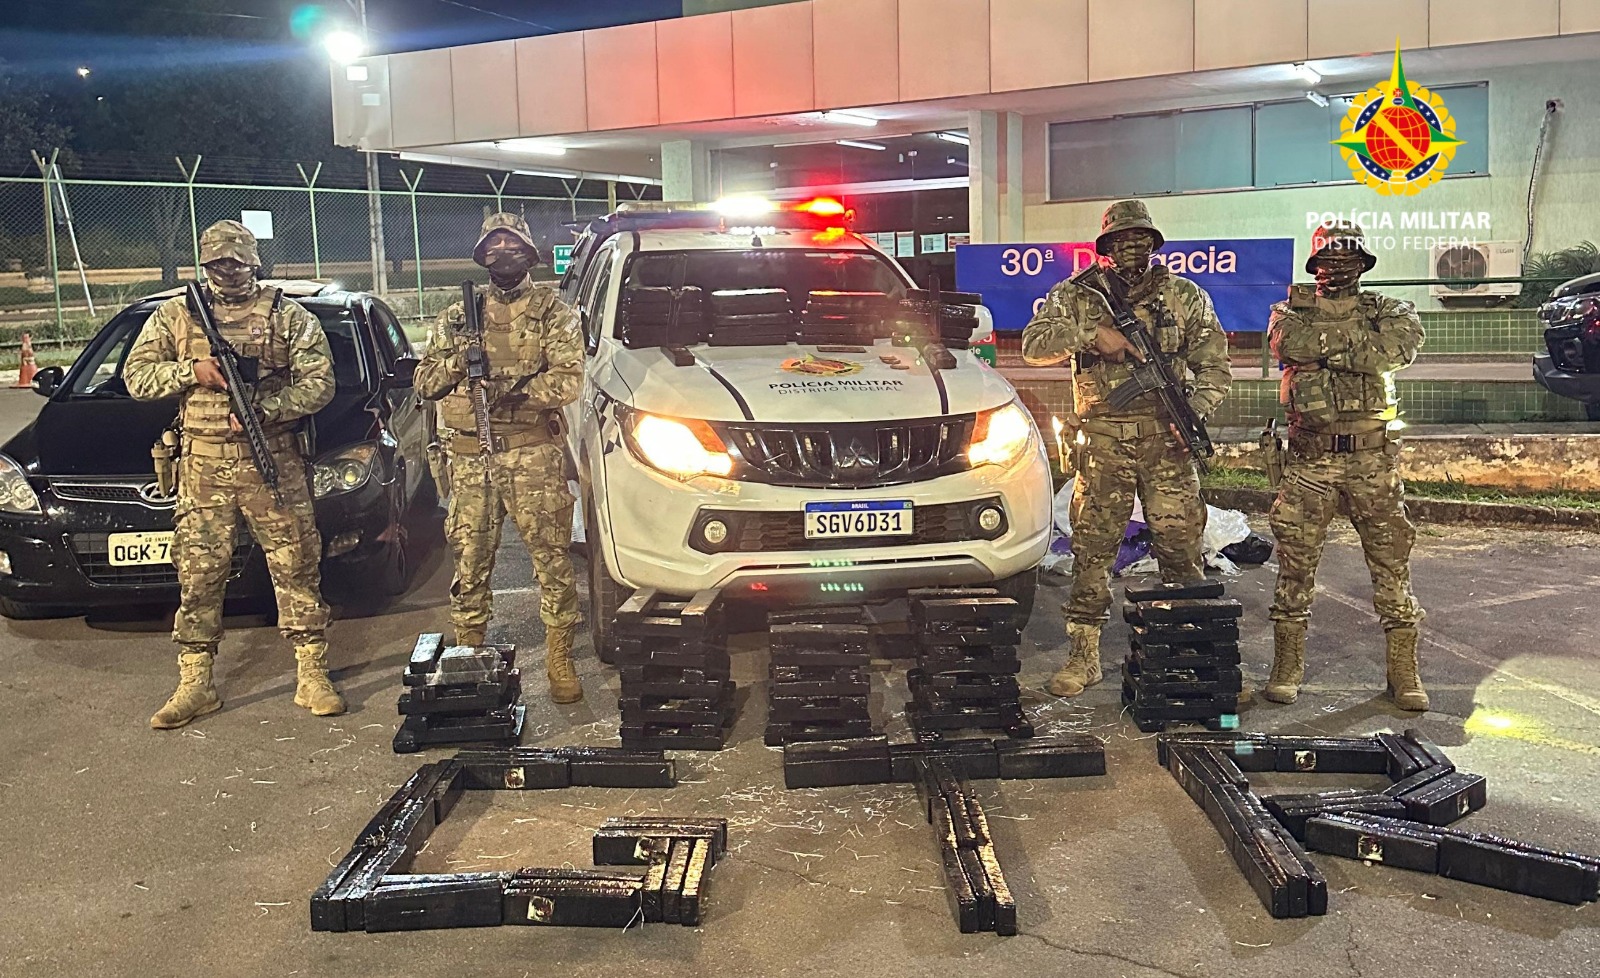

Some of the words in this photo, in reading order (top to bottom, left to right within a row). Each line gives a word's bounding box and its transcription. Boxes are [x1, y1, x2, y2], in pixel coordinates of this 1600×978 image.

[1001, 248, 1055, 276] 30ª
[1073, 245, 1236, 274] Dgacia
[769, 381, 834, 390] POLÍCIA
[778, 387, 839, 395] DISTRITO
[816, 512, 902, 534] SGV6D31
